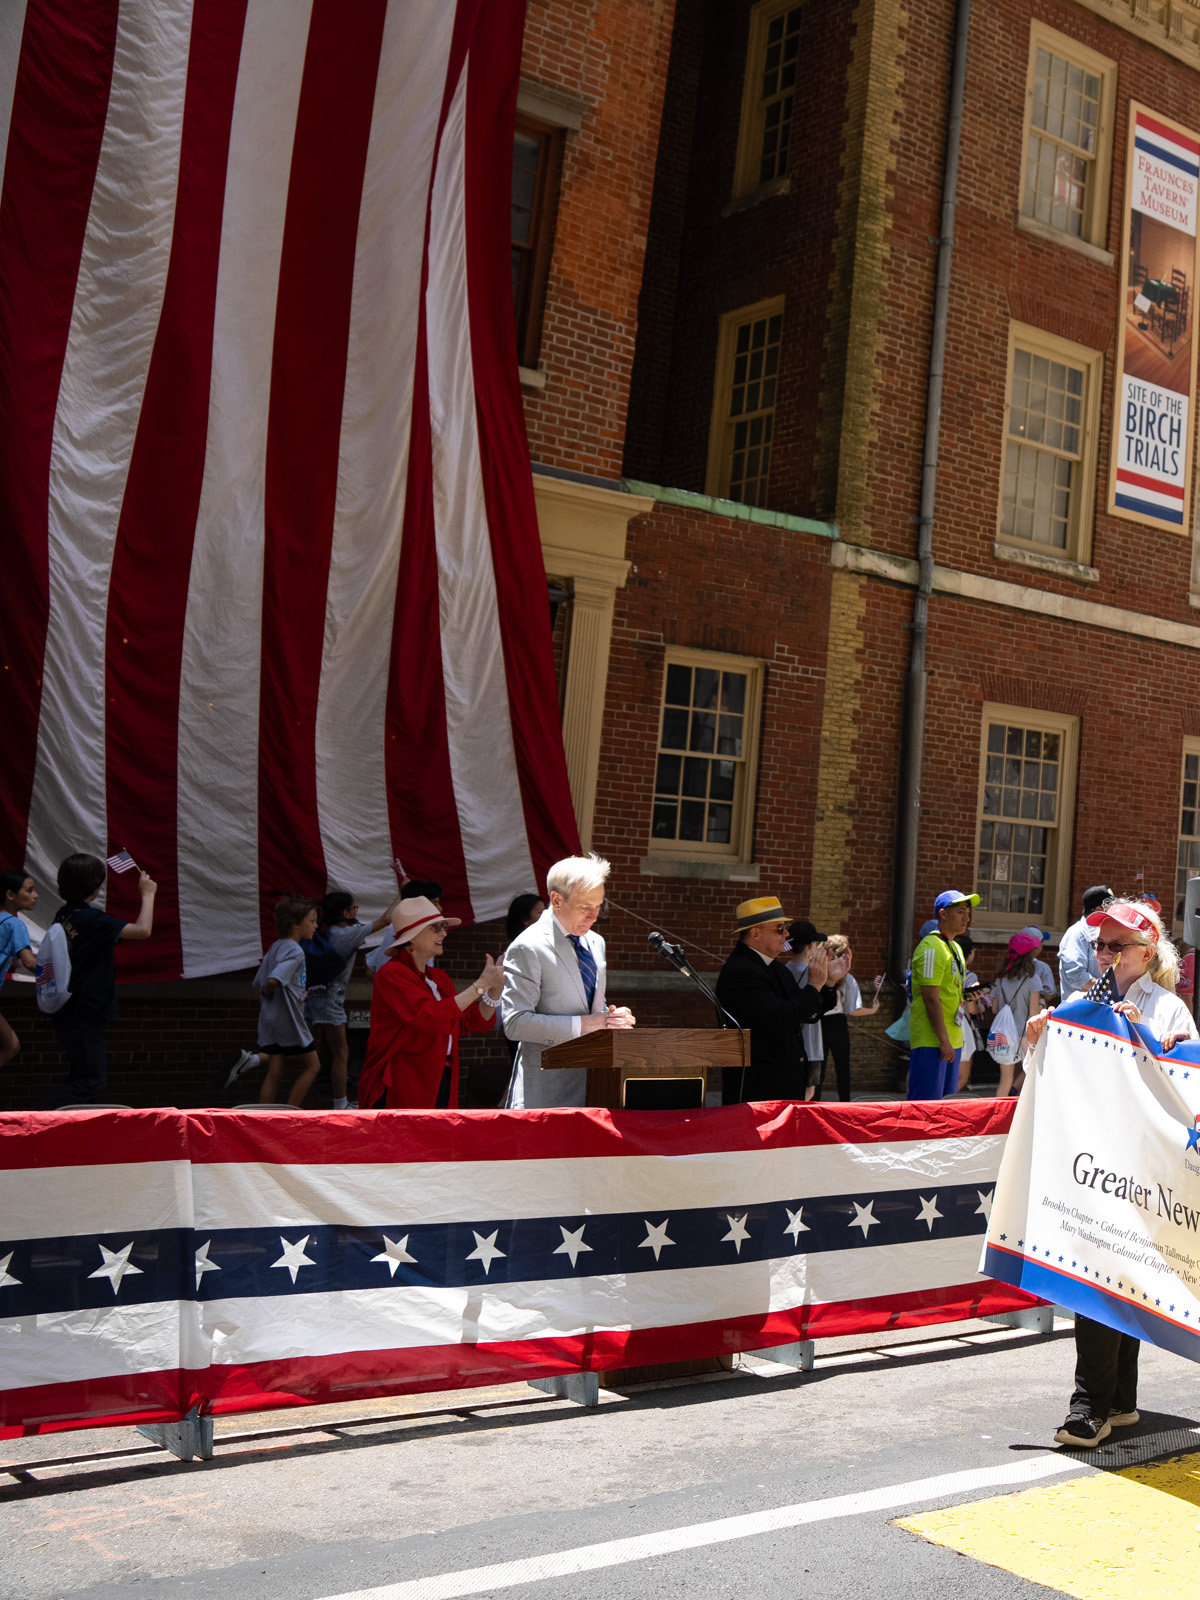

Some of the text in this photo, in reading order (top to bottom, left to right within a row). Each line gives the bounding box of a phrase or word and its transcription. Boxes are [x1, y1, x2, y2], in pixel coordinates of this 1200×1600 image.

[1138, 155, 1194, 195] FRAUNCES
[1144, 175, 1187, 207] TAVERN
[1140, 190, 1188, 226] MUSEUM
[1127, 383, 1182, 416] SITE OF THE
[1126, 401, 1182, 448] BIRCH
[1125, 435, 1179, 476] TRIALS
[1073, 1152, 1151, 1211] Greater
[1156, 1183, 1200, 1233] New
[1042, 1196, 1070, 1216] Brooklyn
[1071, 1207, 1094, 1226] Chapter
[1100, 1220, 1130, 1239] Colonel
[1129, 1231, 1164, 1253] Benjamin
[1165, 1244, 1196, 1269] Tallmadge
[1059, 1219, 1077, 1237] Mary
[1078, 1227, 1111, 1250] Washington
[1112, 1243, 1145, 1263] Colonial
[1144, 1255, 1174, 1275] Chapter
[1181, 1269, 1197, 1285] New
